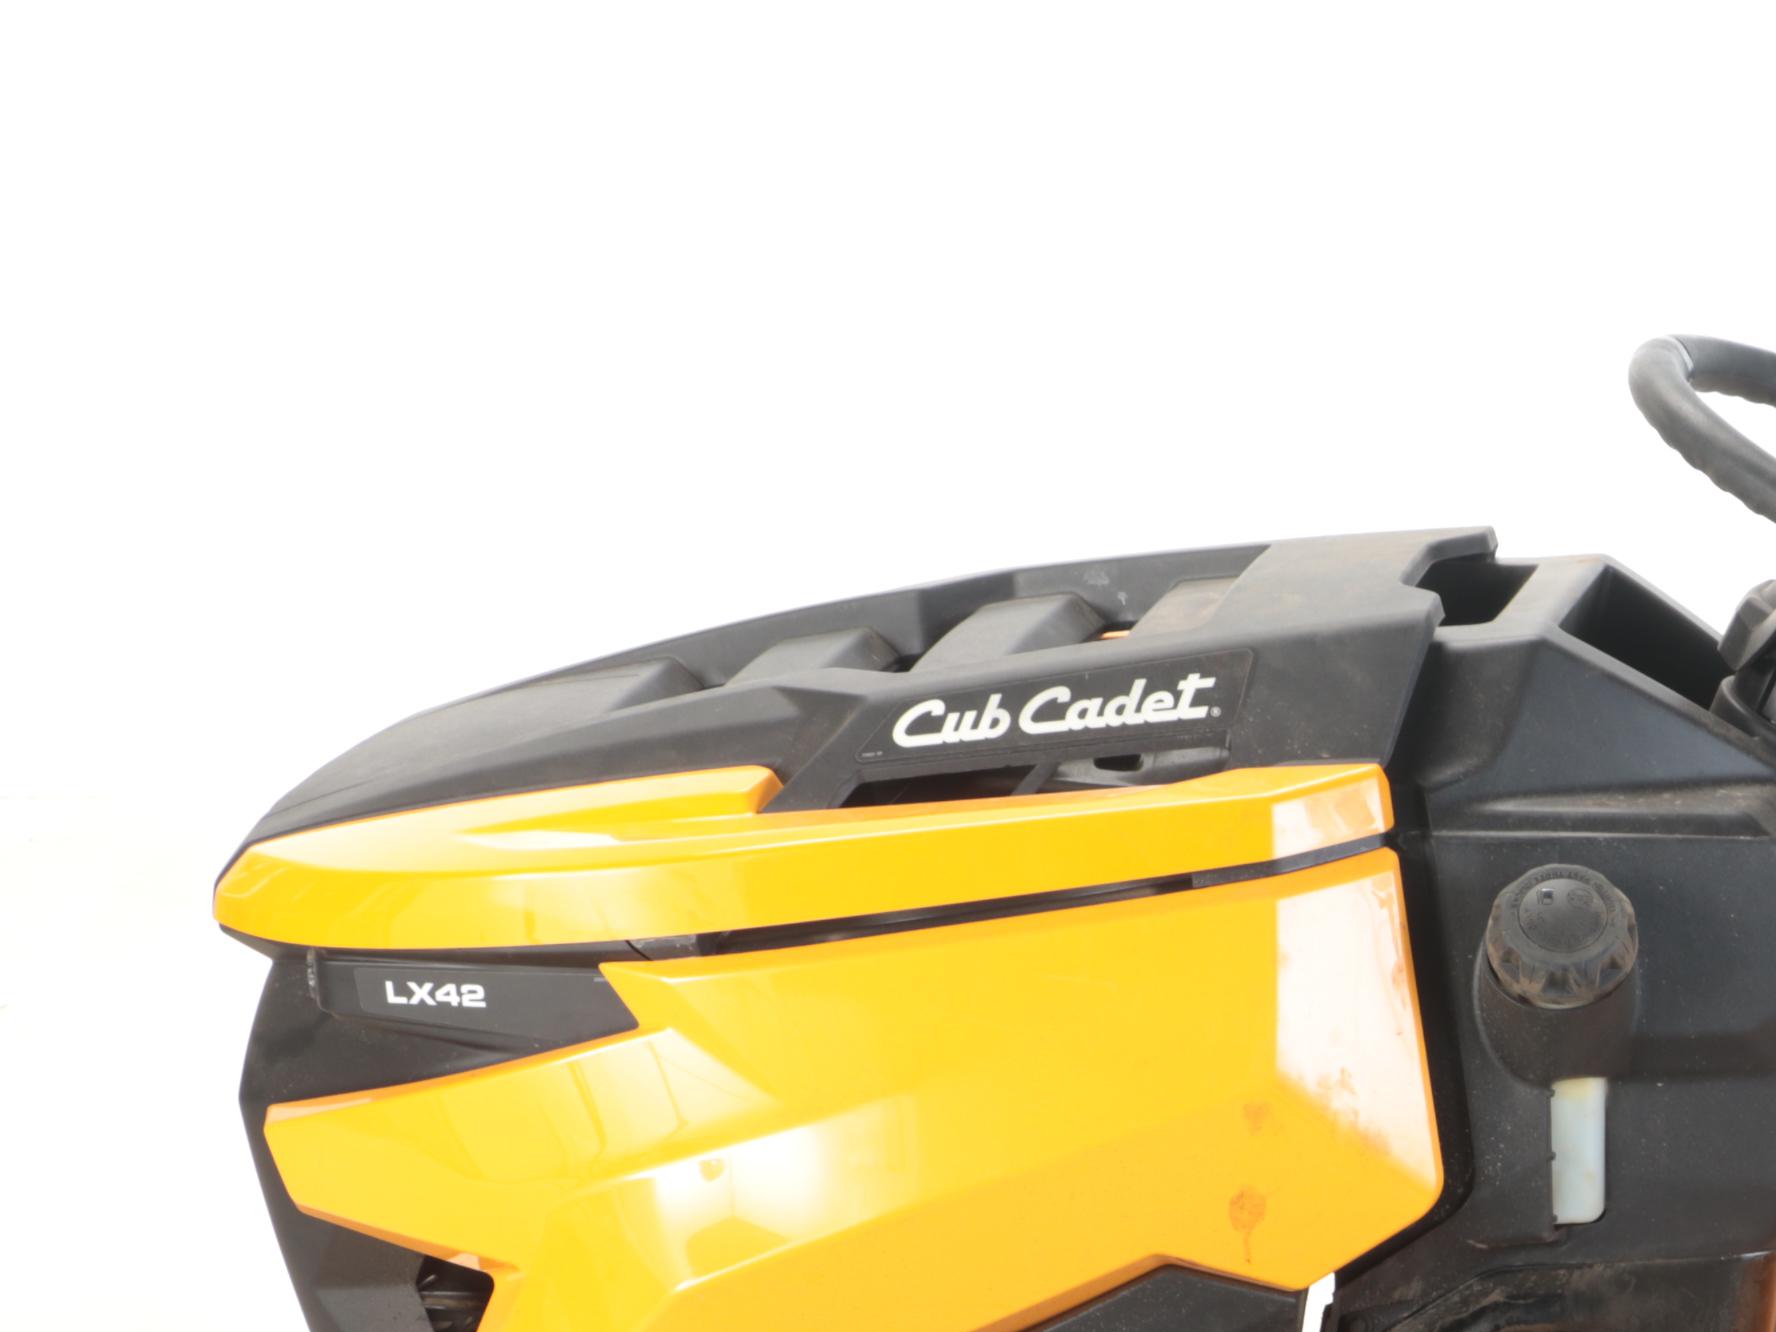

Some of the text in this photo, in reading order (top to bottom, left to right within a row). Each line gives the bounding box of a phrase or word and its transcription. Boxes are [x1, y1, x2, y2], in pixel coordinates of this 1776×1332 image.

[892, 672, 1218, 749] Cub Cadet
[384, 979, 488, 1009] LX42
